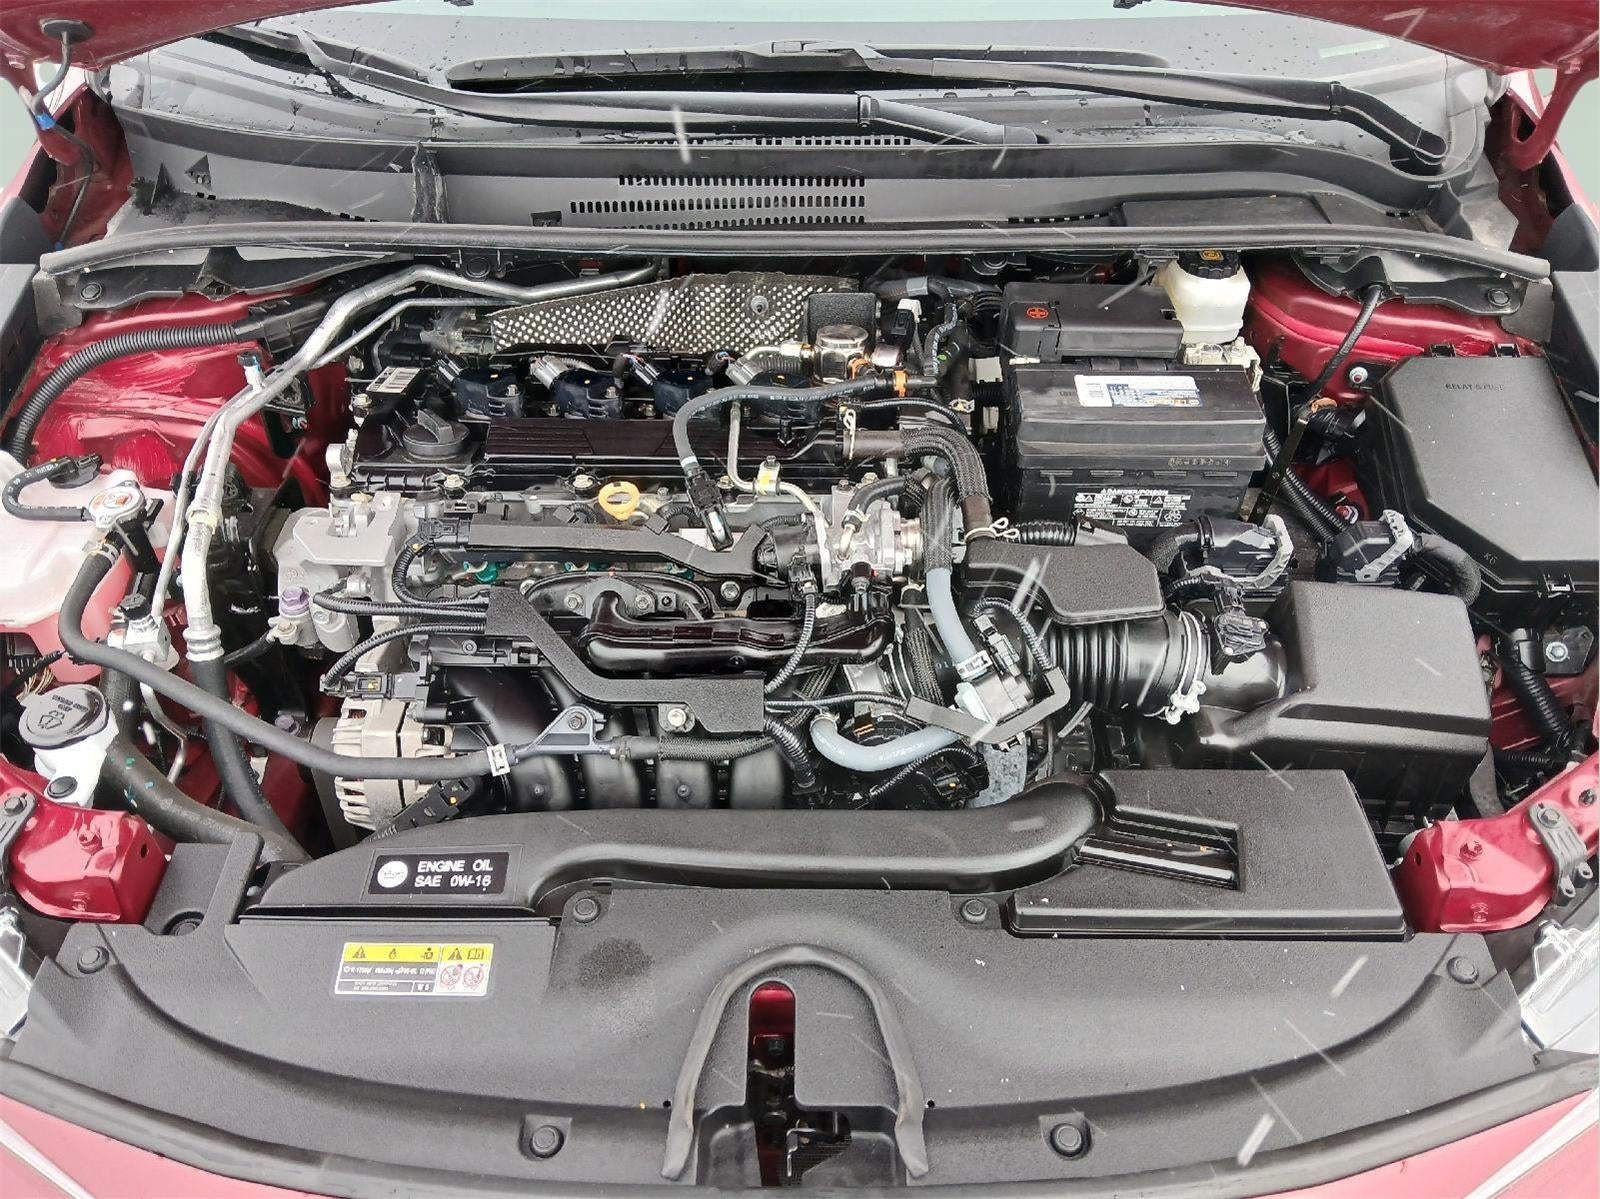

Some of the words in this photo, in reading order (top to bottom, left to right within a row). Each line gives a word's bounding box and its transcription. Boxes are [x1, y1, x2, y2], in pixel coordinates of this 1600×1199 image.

[417, 860, 466, 873] ENGINE
[472, 858, 494, 872] OIL
[414, 875, 442, 888] SAE
[450, 874, 492, 888] 0W-16
